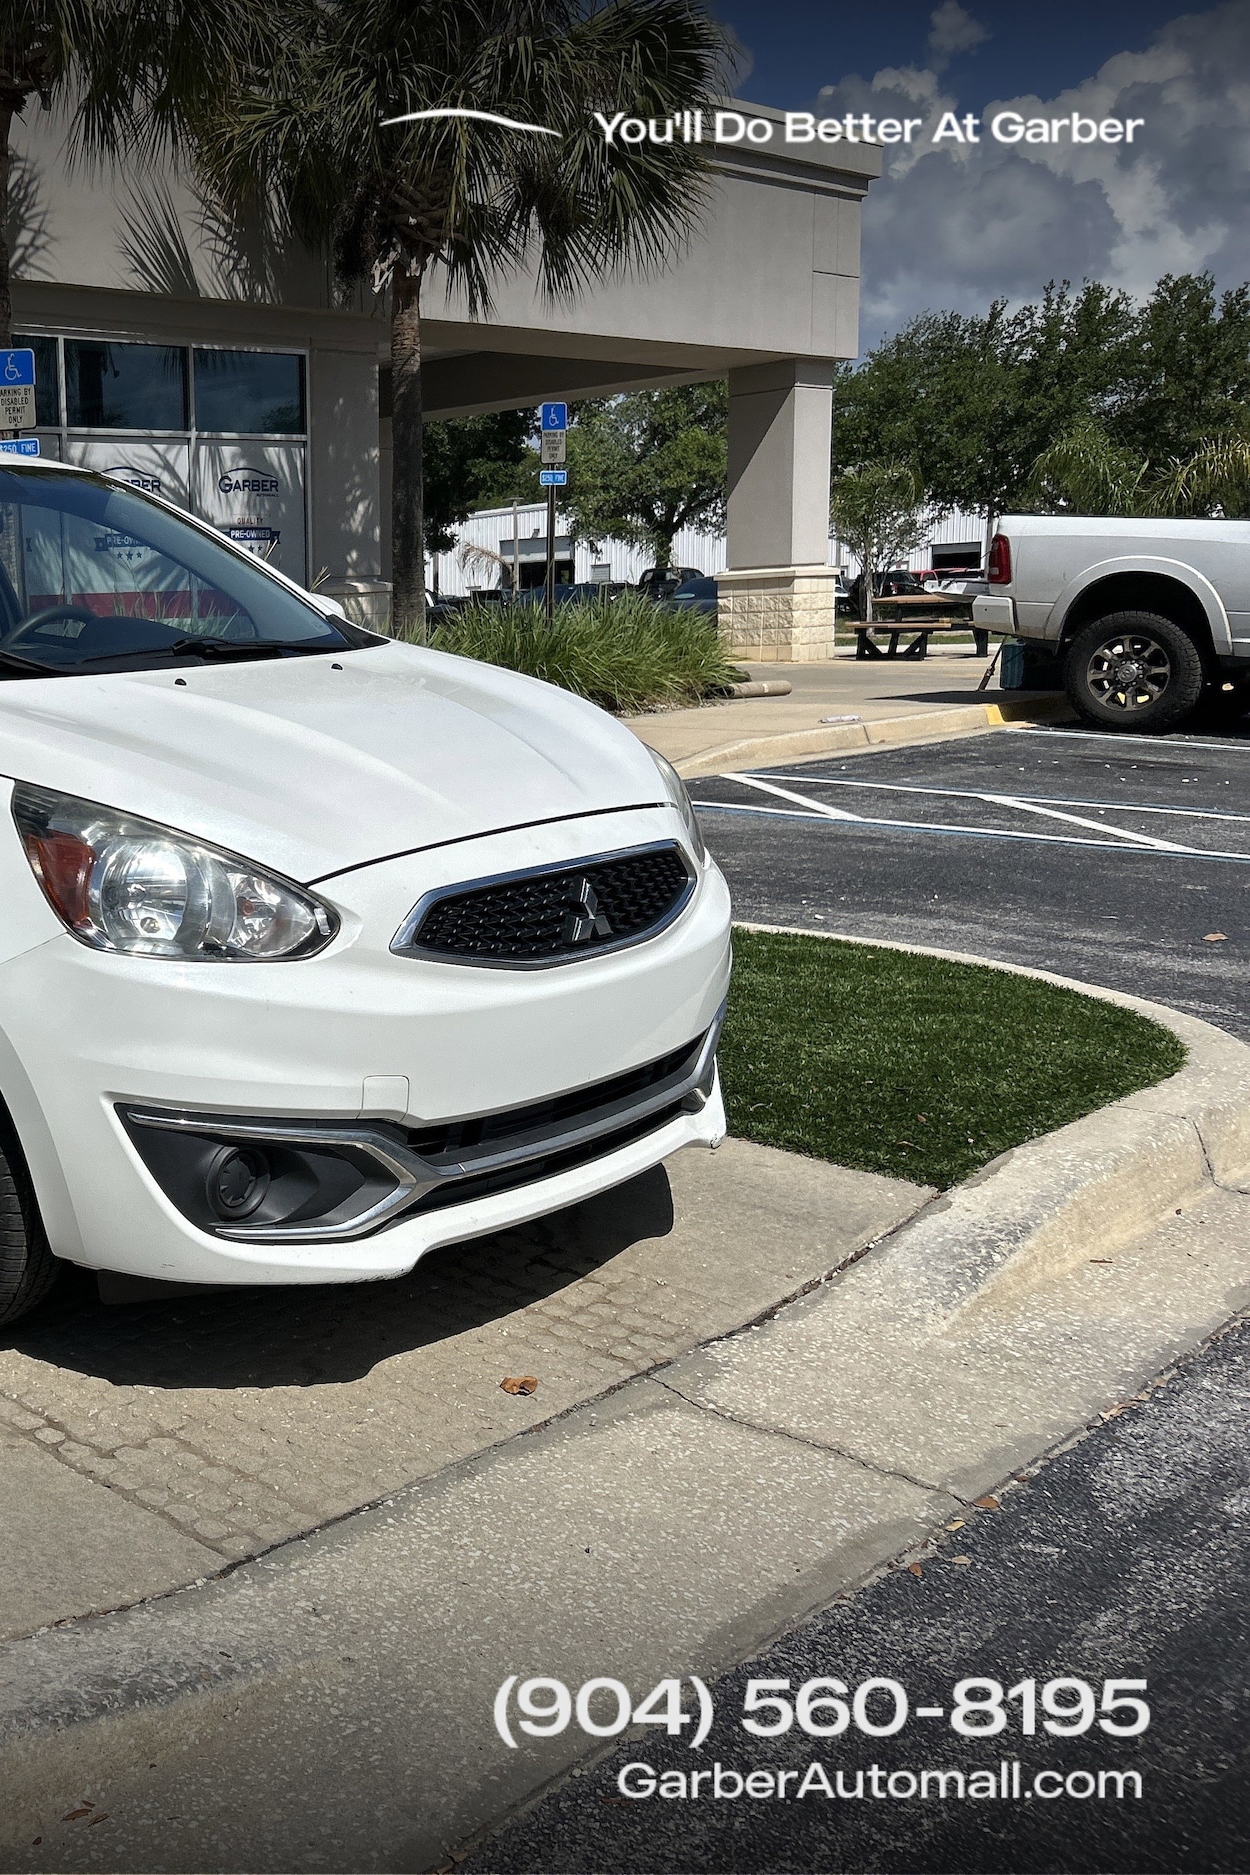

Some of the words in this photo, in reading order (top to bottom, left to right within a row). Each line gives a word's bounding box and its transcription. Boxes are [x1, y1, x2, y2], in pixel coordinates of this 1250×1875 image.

[24, 388, 31, 396] BY
[1, 397, 28, 406] DISABLED
[5, 406, 25, 415] PERMIT
[8, 416, 23, 424] ONLY
[21, 443, 36, 453] FINE
[219, 475, 279, 493] GARBER
[230, 529, 270, 539] PRE-OWNED
